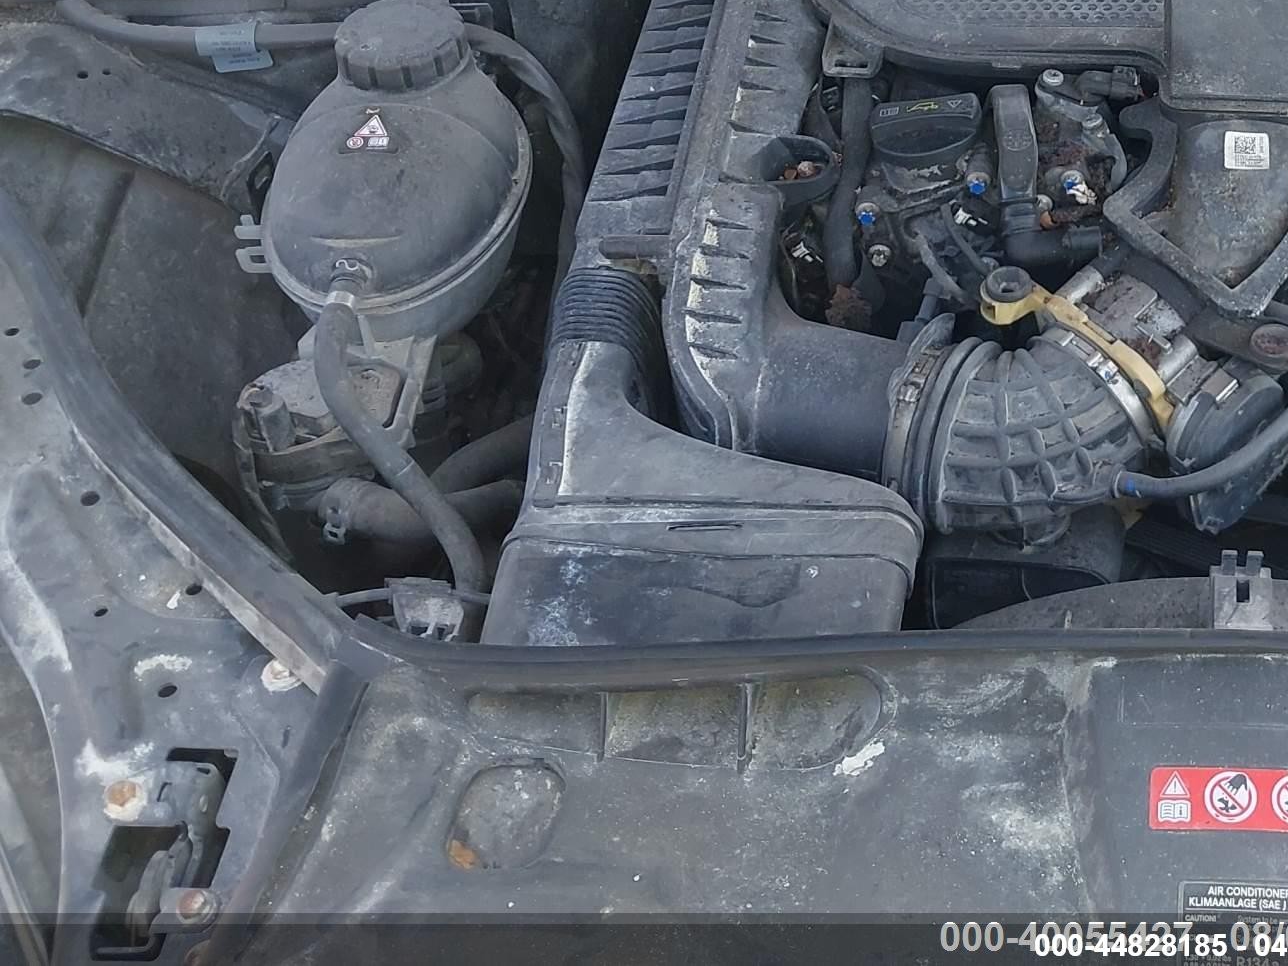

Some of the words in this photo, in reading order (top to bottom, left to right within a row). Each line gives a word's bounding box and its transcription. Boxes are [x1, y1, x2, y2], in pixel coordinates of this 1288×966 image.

[1207, 886, 1224, 896] AIR
[1188, 897, 1257, 909] KLIMAANLAGE
[1258, 898, 1280, 911] (SAE
[1282, 901, 1287, 911] J
